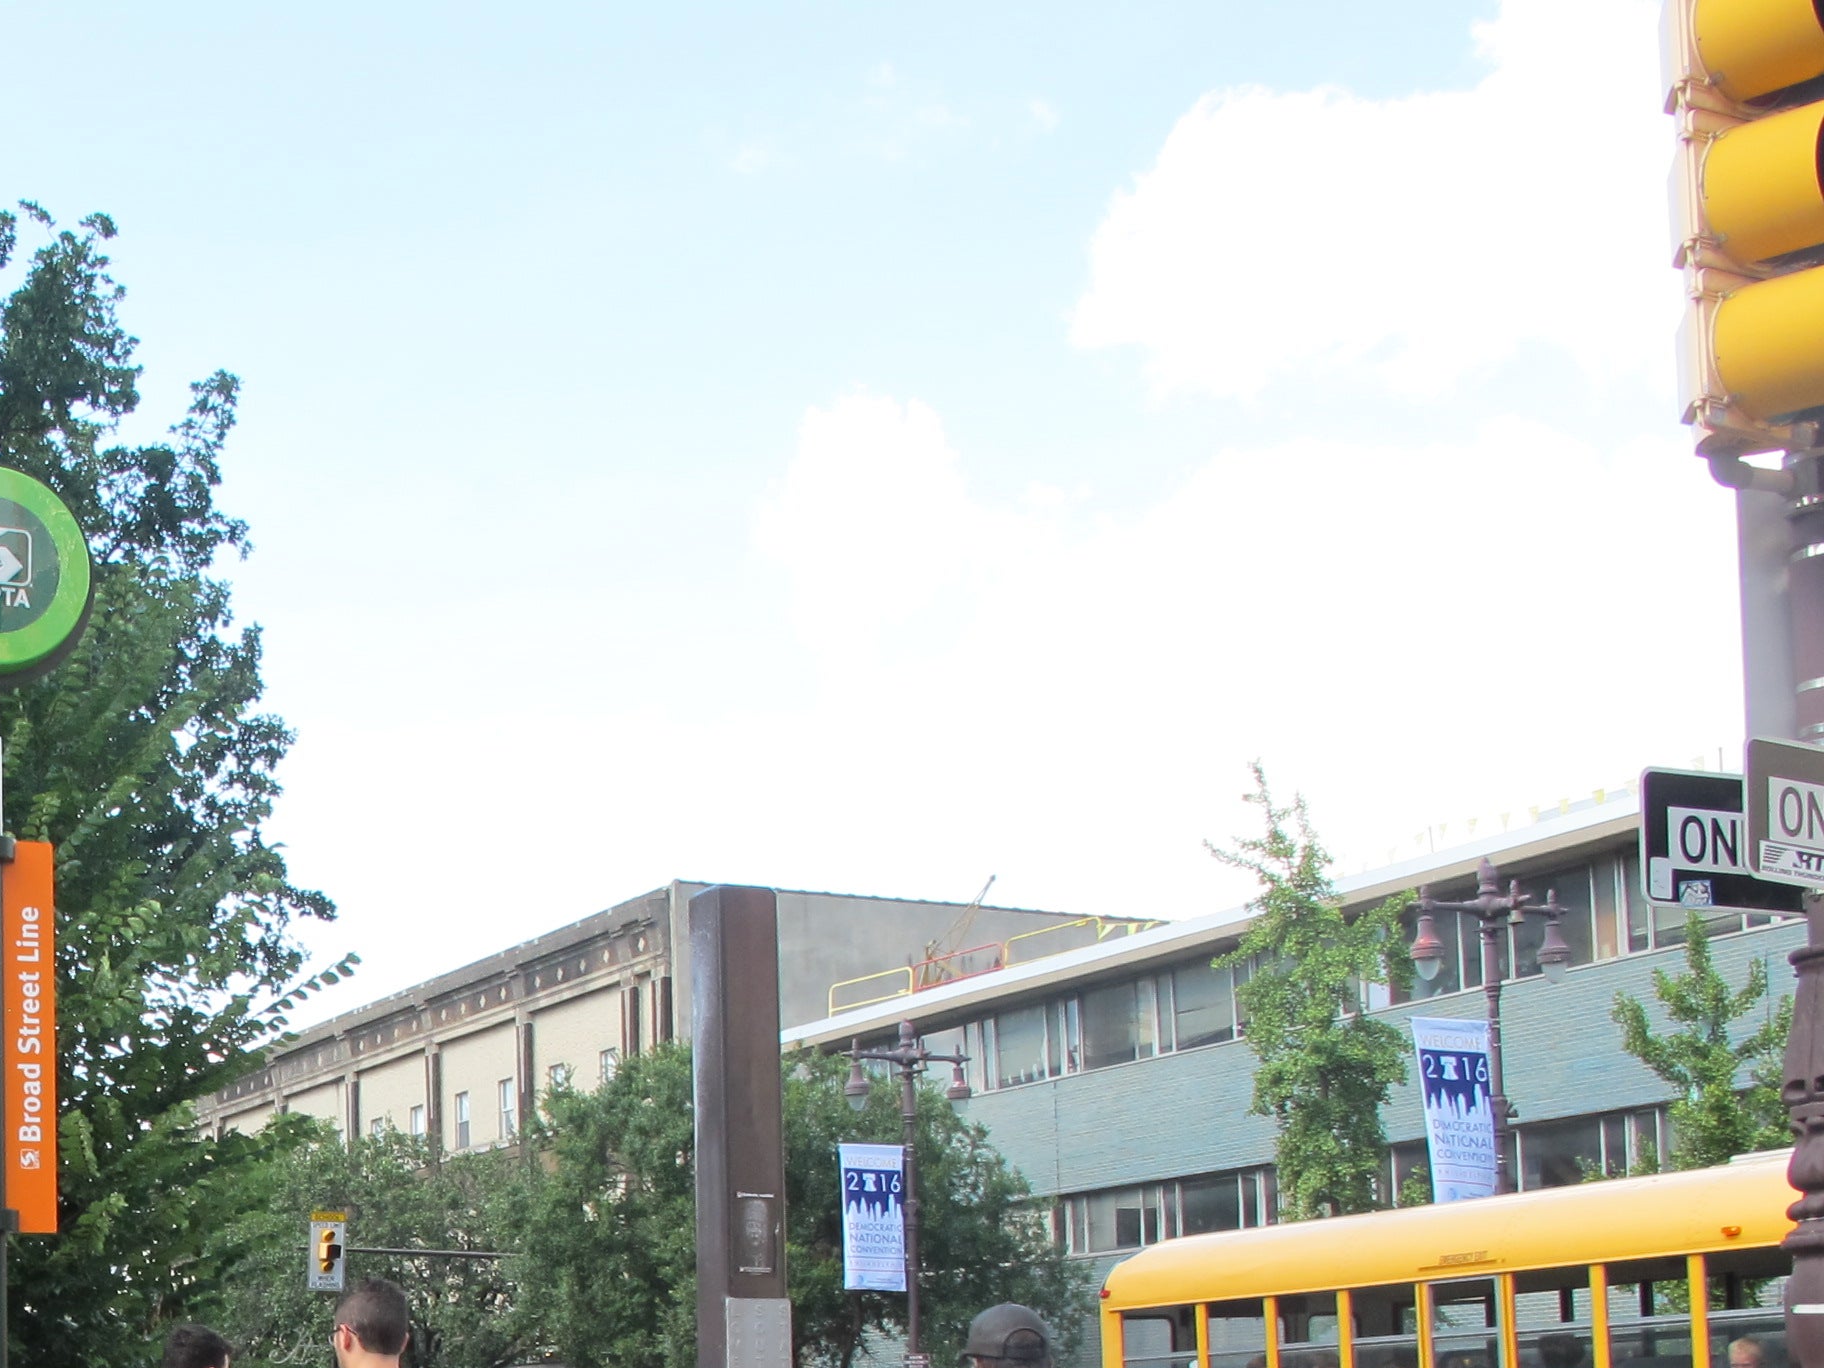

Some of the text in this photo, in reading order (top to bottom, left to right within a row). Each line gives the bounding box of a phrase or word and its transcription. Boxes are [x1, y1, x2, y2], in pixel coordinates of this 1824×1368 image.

[1679, 815, 1745, 868] ON
[16, 905, 41, 1143] Broad Street Line
[1434, 1134, 1493, 1150] NATIONAL
[848, 1222, 902, 1232] DEMOCRATIC
[849, 1233, 903, 1244] NATIONAL
[850, 1245, 903, 1255] CONVENTION
